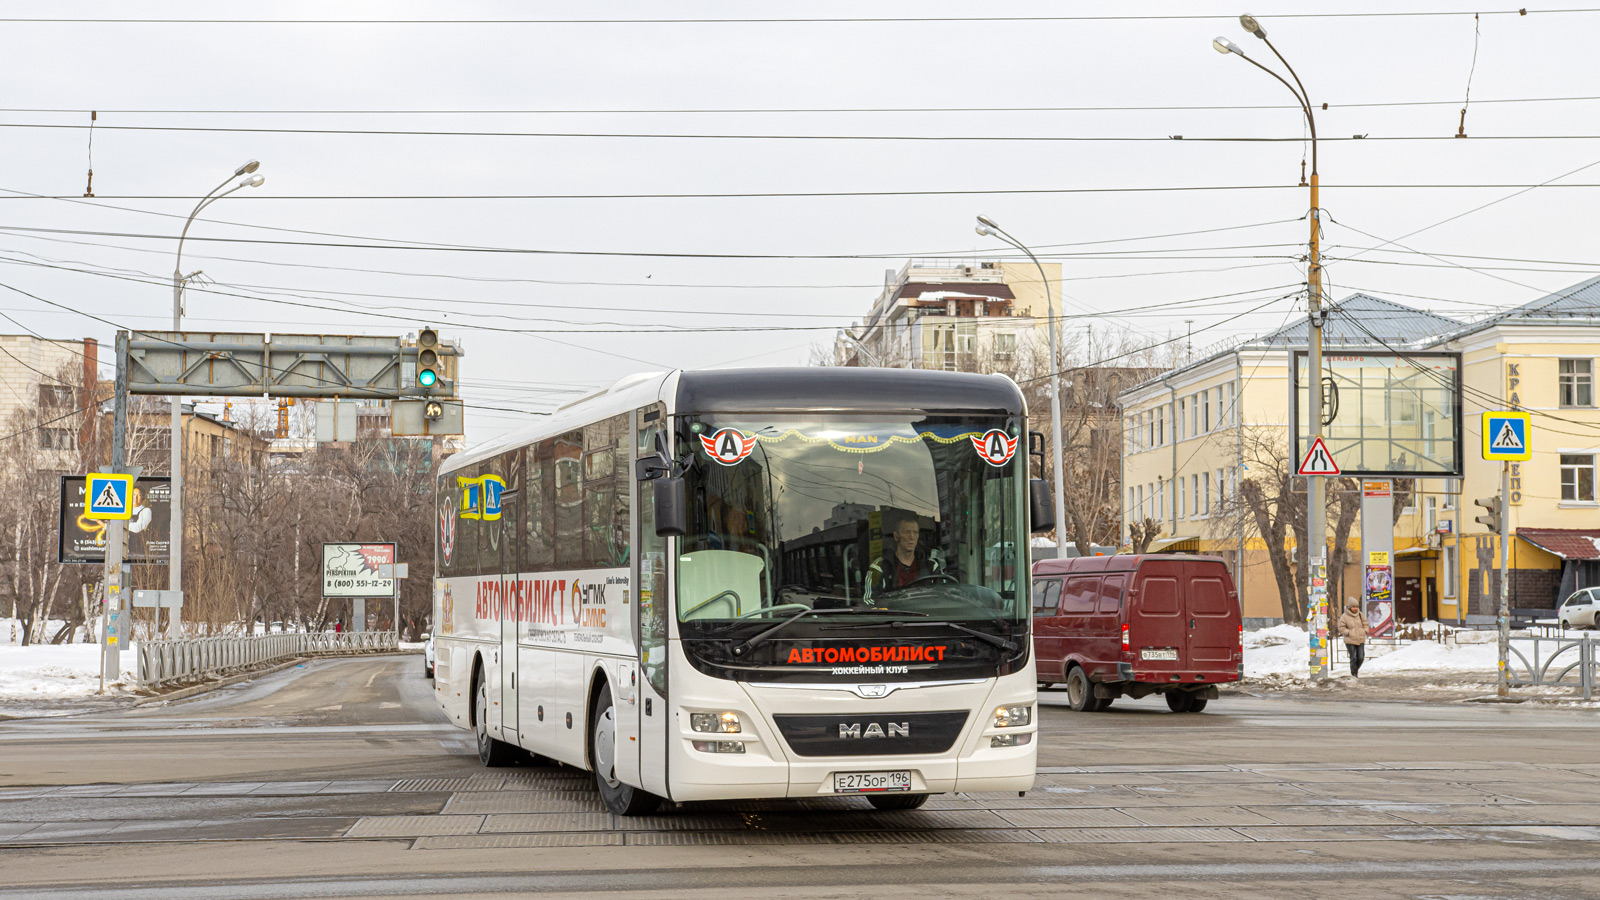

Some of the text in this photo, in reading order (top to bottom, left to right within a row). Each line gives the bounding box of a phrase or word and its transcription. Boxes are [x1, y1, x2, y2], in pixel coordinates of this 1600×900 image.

[845, 435, 878, 443] MAN
[334, 580, 354, 588] (800)
[475, 579, 566, 627] АВТОМОБИЛИСТ
[582, 584, 606, 605] УГМК
[582, 608, 606, 628] UMMC
[787, 645, 947, 663] АВТОМОБИЛИСТ
[831, 665, 909, 675] ХОККЕЙНЫЙ КЛУБ
[838, 722, 910, 739] MAN
[889, 772, 907, 783] 196
